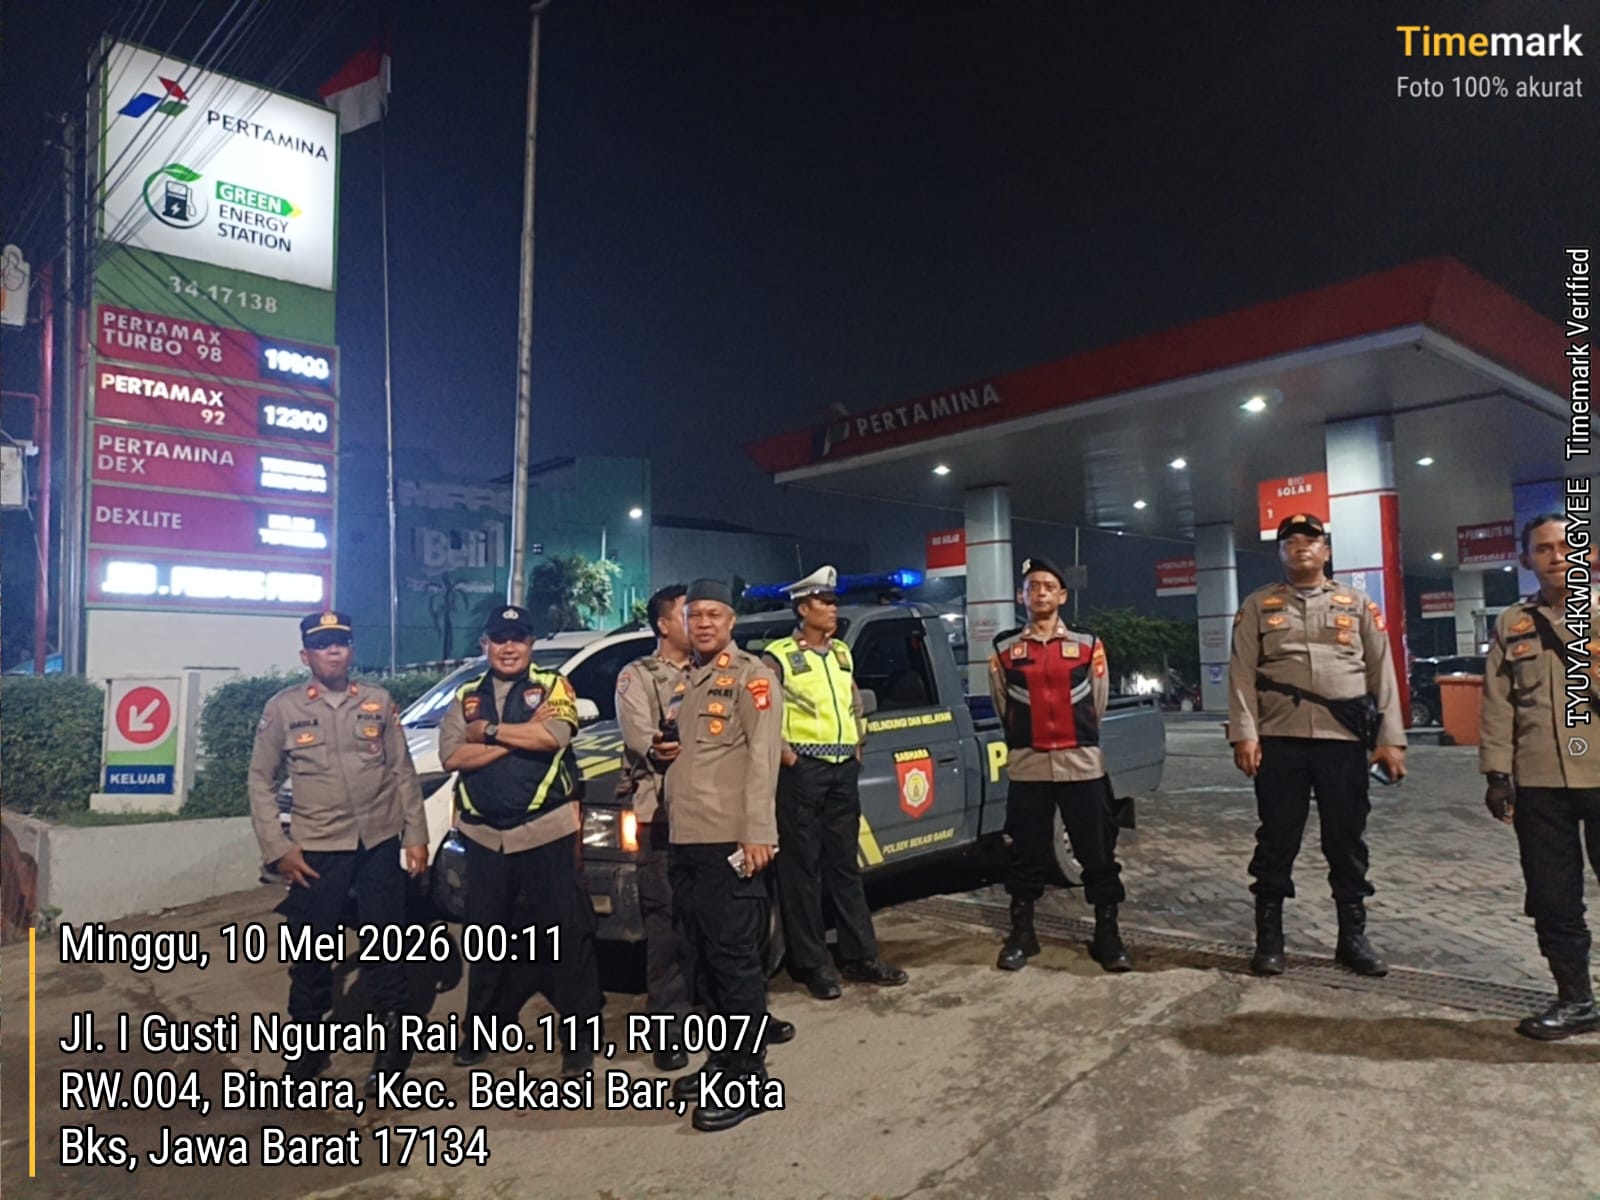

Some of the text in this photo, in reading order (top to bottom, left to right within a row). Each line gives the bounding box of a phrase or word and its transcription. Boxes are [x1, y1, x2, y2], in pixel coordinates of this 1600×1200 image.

[207, 109, 329, 161] PERTAMINA
[219, 182, 283, 214] GREEN
[219, 204, 289, 233] ENERGY
[217, 222, 292, 252] STATION
[103, 311, 221, 345] PERTAMAX
[104, 328, 222, 362] TURBO 98
[101, 373, 223, 407] PERTAMAX
[200, 409, 226, 425] 92
[855, 383, 1000, 437] PERTAMINA
[98, 455, 146, 474] DEX
[99, 434, 235, 466] PERTAMINA
[1277, 483, 1312, 498] SOLAR
[96, 505, 182, 529] DEXLITE
[707, 688, 733, 698] POLRI
[109, 772, 166, 785] KELUAR
